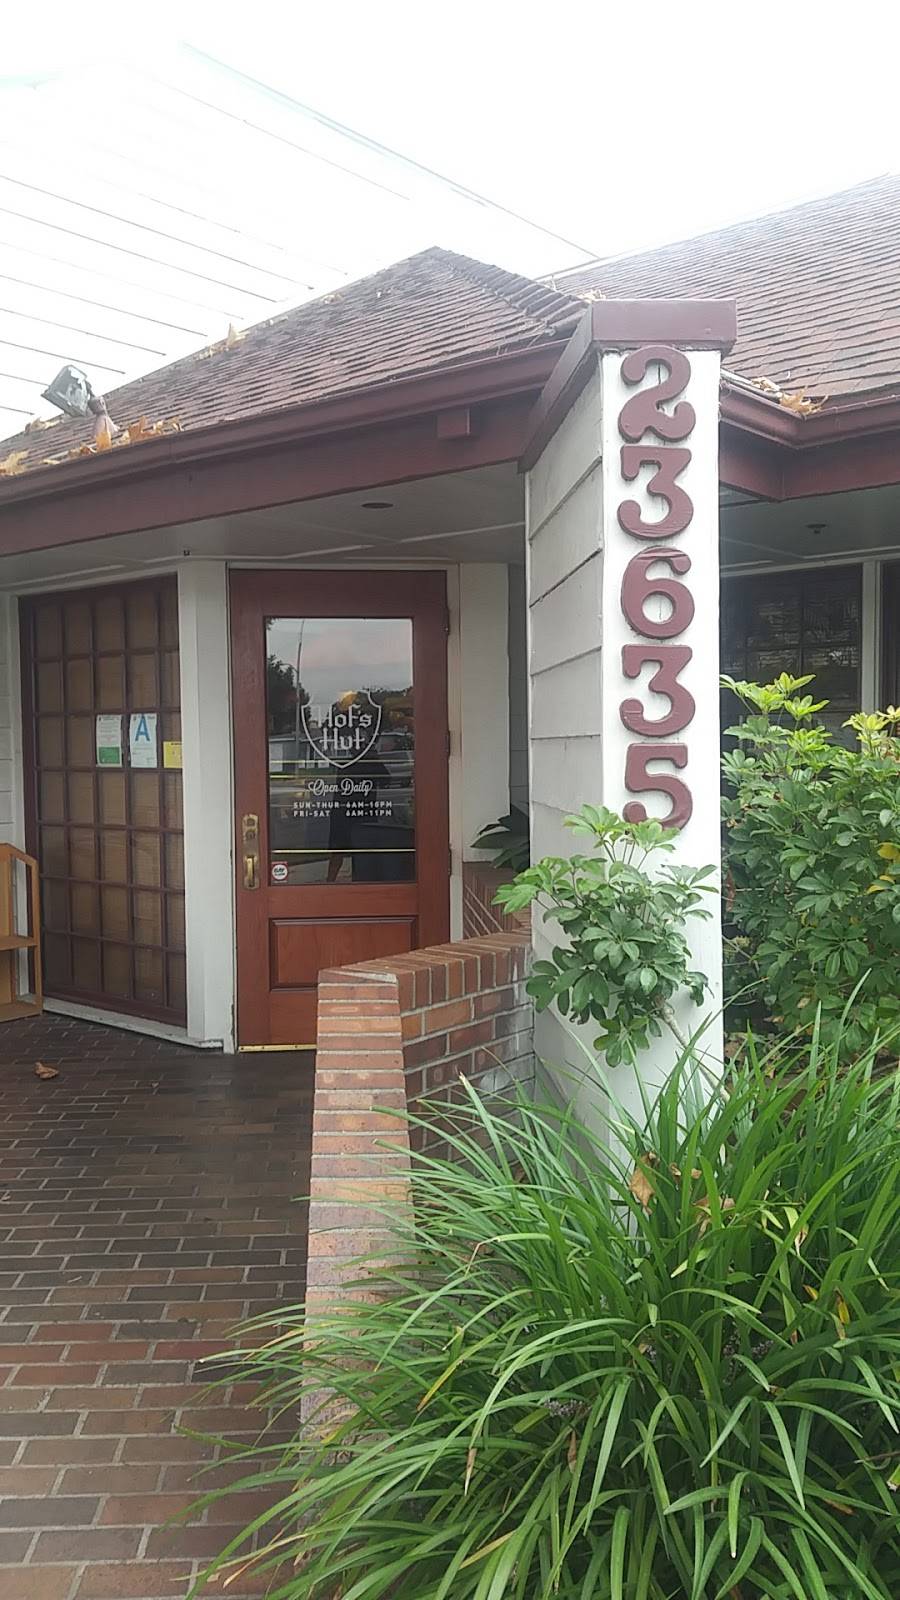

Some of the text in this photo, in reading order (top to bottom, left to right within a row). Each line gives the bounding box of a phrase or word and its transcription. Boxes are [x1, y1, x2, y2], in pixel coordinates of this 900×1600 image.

[617, 345, 695, 831] 23635
[317, 704, 373, 727] Hof's
[135, 714, 150, 741] A
[319, 728, 365, 750] Hut
[308, 778, 373, 797] Open Daily
[293, 801, 340, 809] SUN-THUR
